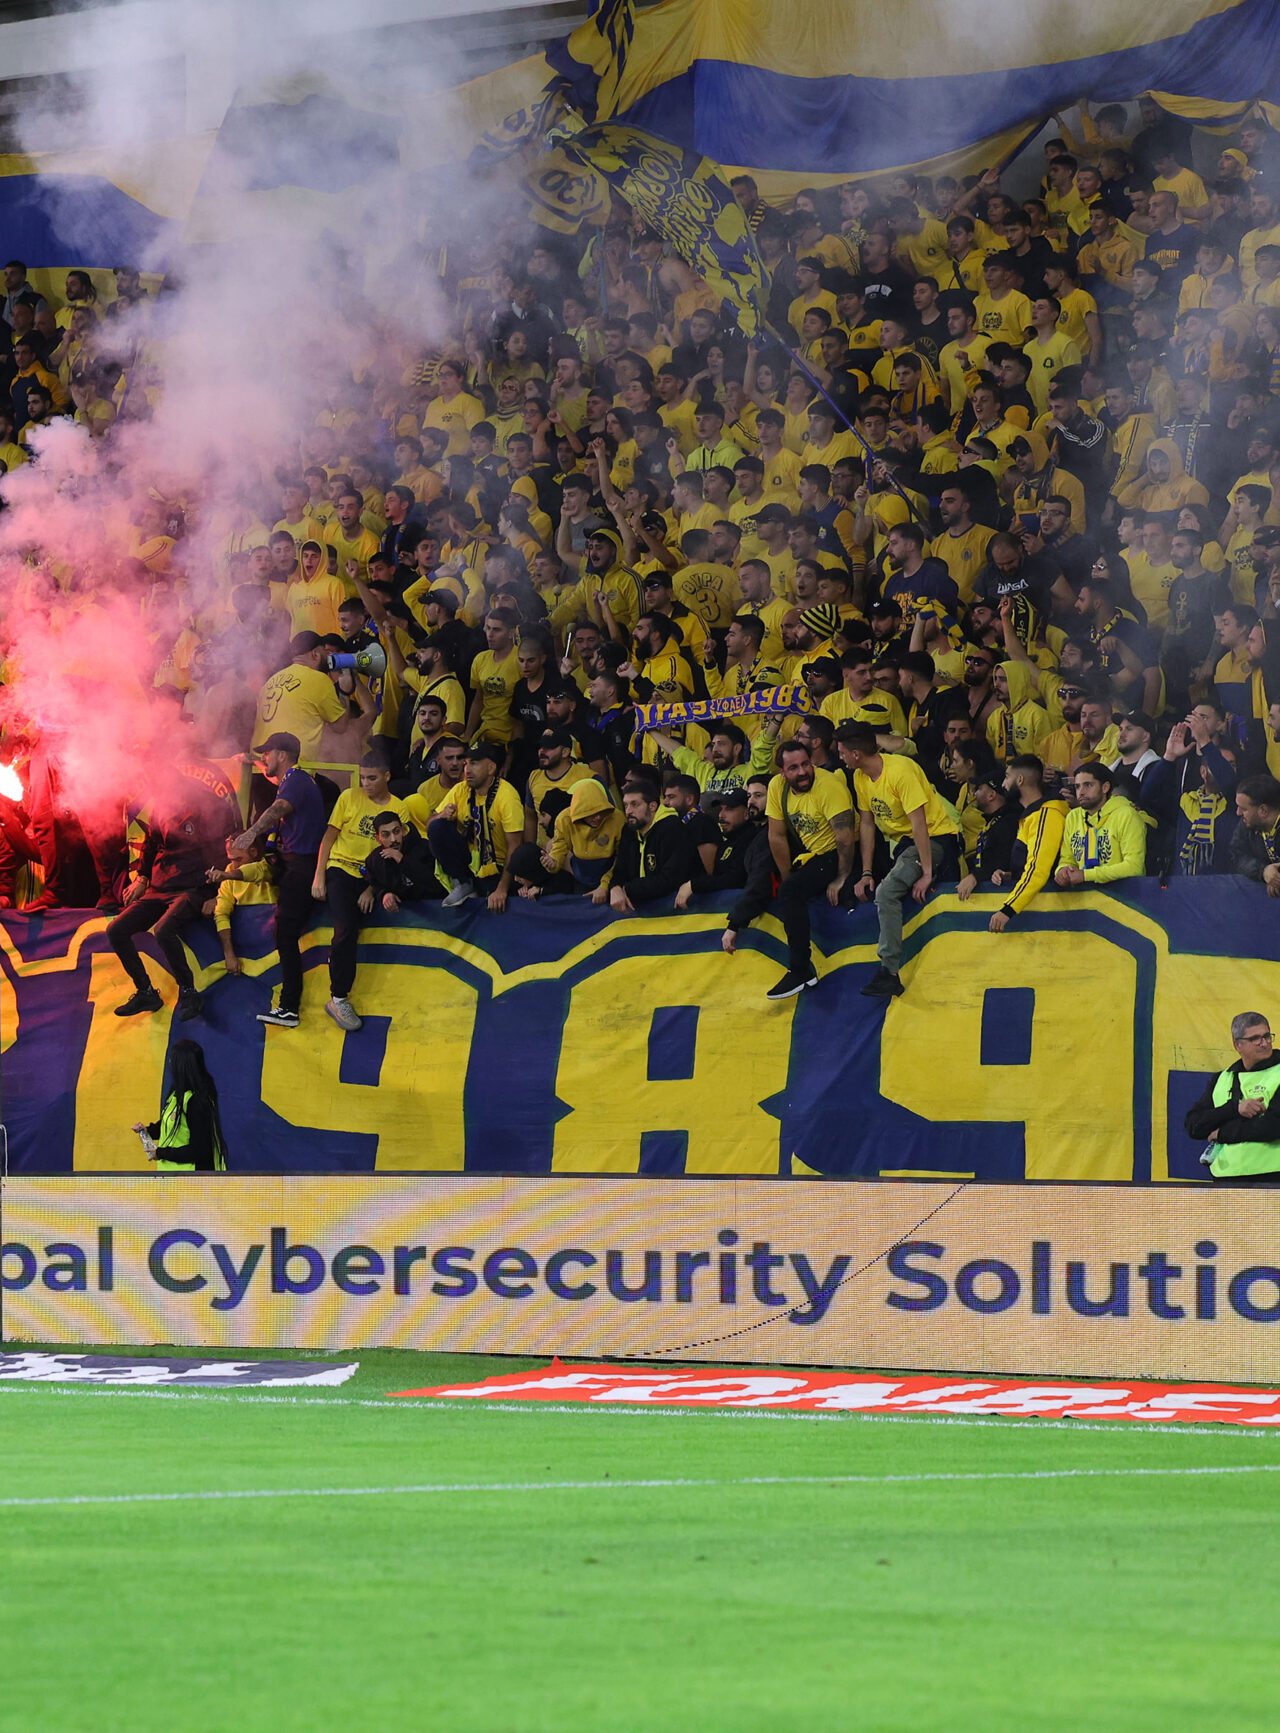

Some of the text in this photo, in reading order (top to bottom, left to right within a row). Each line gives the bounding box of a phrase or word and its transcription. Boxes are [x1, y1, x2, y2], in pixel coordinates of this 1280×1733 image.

[148, 1226, 852, 1326] Cybersecurity
[886, 1240, 1280, 1323] Solutio
[436, 1371, 1280, 1423] FONBE
